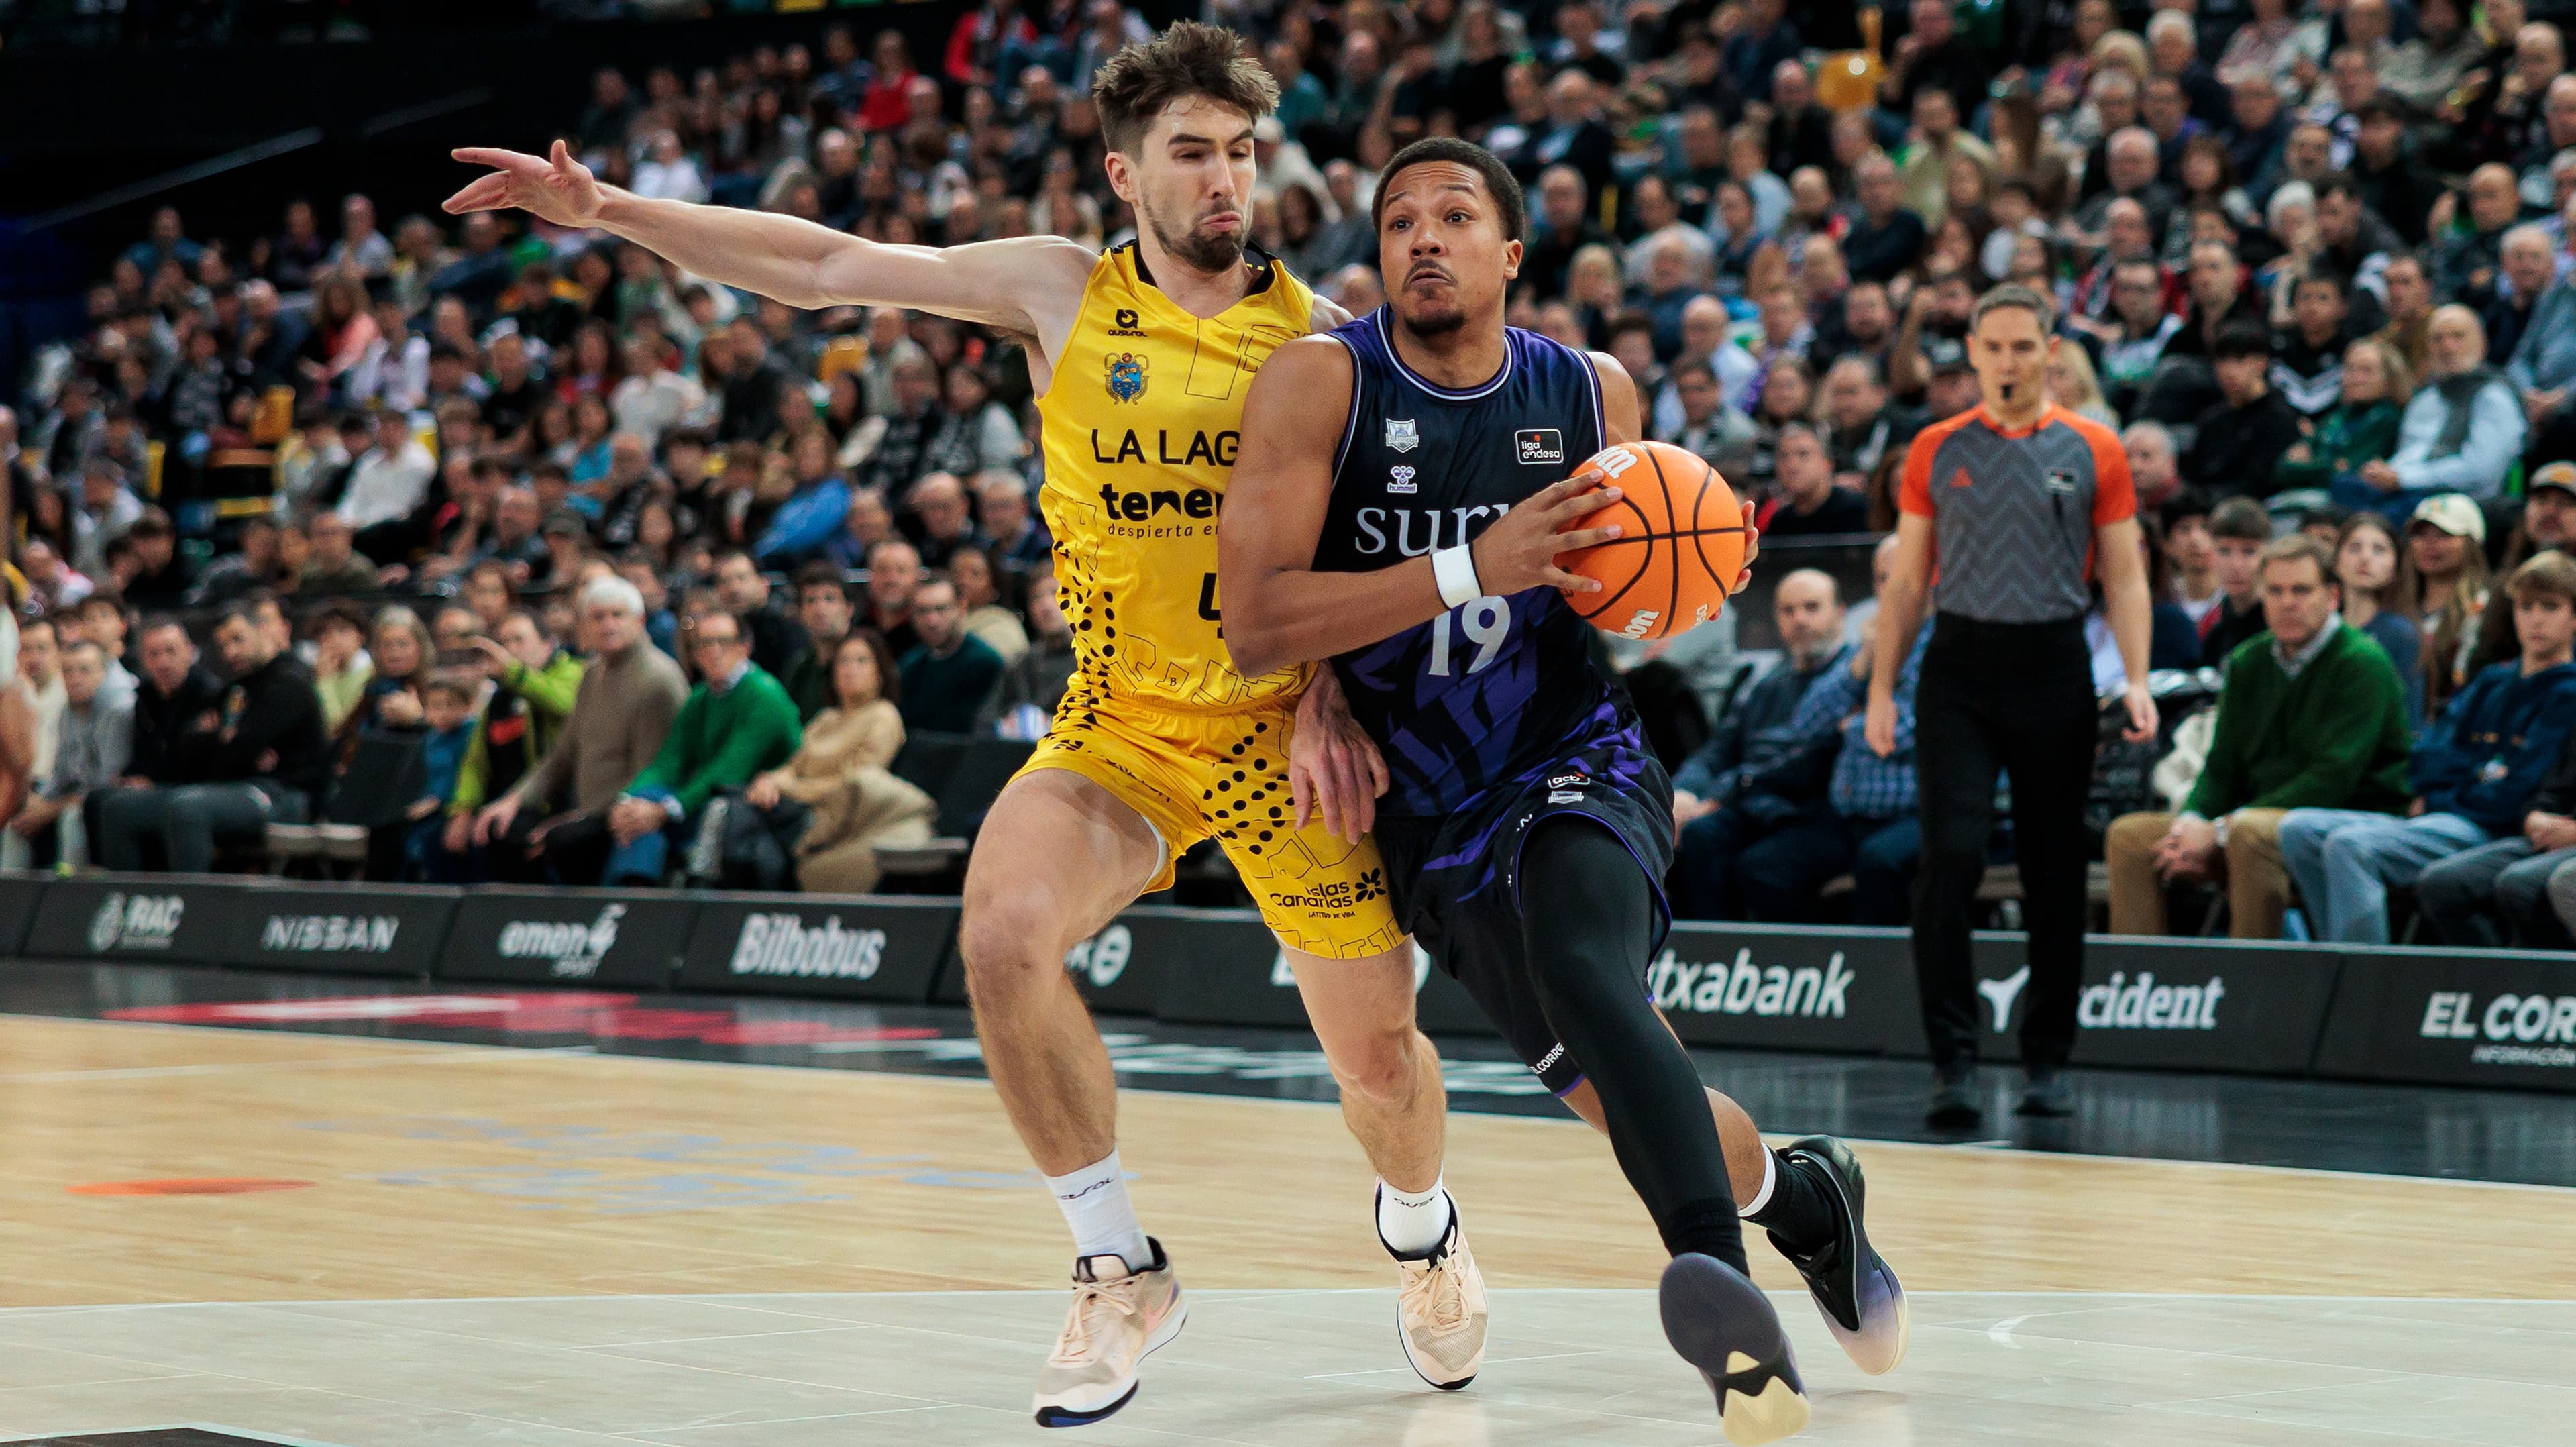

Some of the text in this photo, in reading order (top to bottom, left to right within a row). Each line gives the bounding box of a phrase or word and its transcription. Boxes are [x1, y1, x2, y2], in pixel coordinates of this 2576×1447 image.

[1091, 429, 1146, 464] LA
[1521, 440, 1540, 451] liga
[1523, 449, 1560, 459] endesa
[1108, 523, 1193, 539] despierta
[1428, 595, 1511, 676] 19
[1270, 892, 1353, 908] Canarias
[262, 915, 400, 953] NISSAN
[731, 912, 887, 980] Bilbobus
[2420, 992, 2478, 1038] EL
